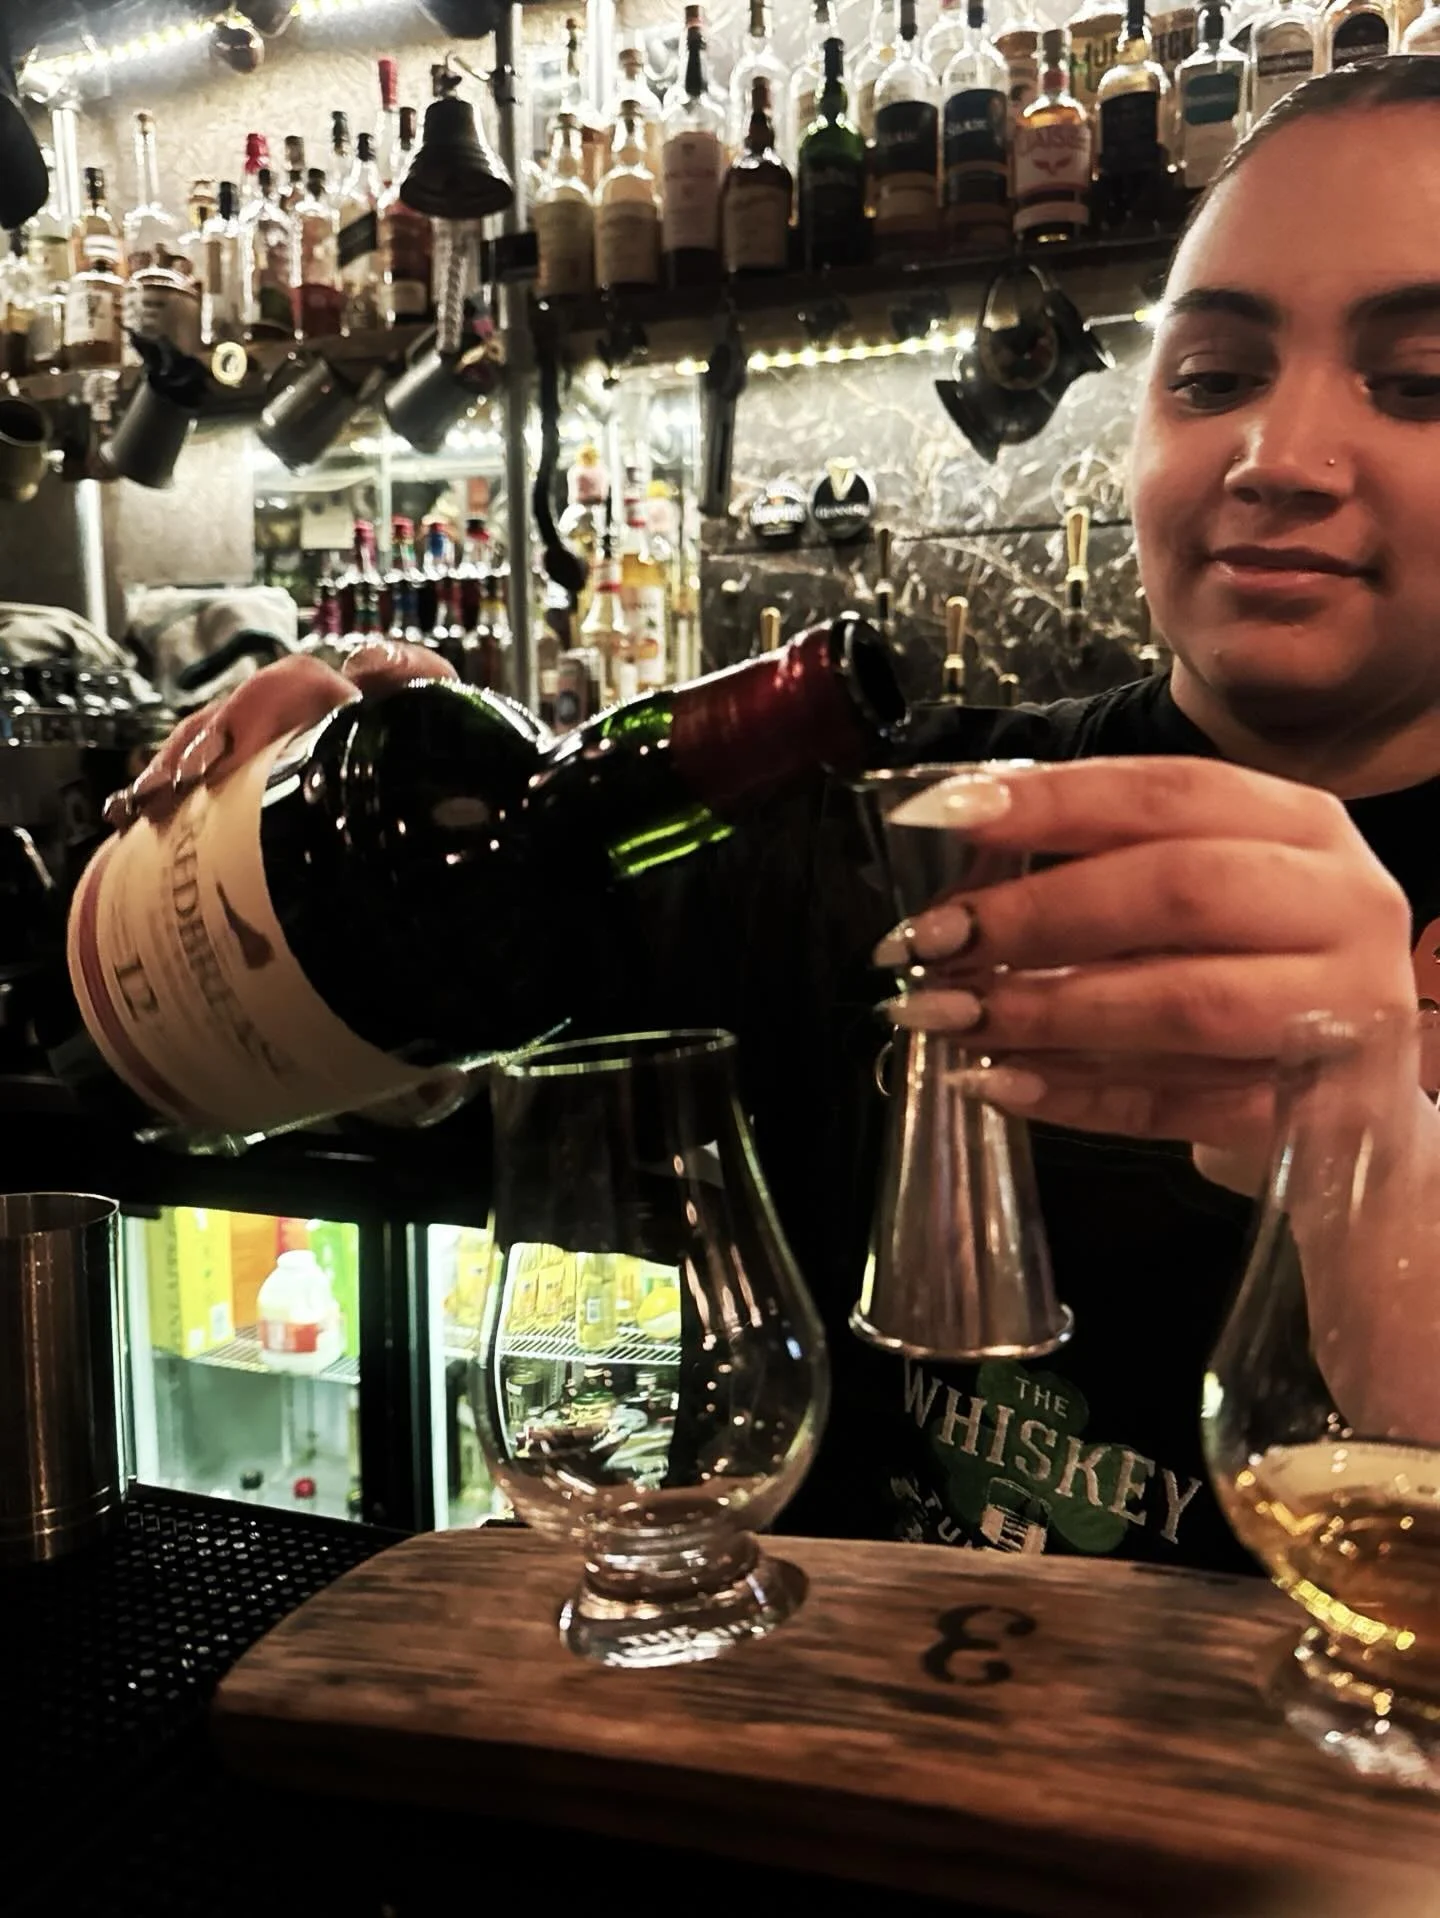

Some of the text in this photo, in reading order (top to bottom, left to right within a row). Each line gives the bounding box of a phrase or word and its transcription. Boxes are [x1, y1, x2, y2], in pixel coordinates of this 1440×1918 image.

[113, 952, 159, 1022] 12
[171, 815, 298, 1078] REDBREA
[903, 1358, 1202, 1545] WHISKEY
[1015, 1376, 1069, 1419] THE
